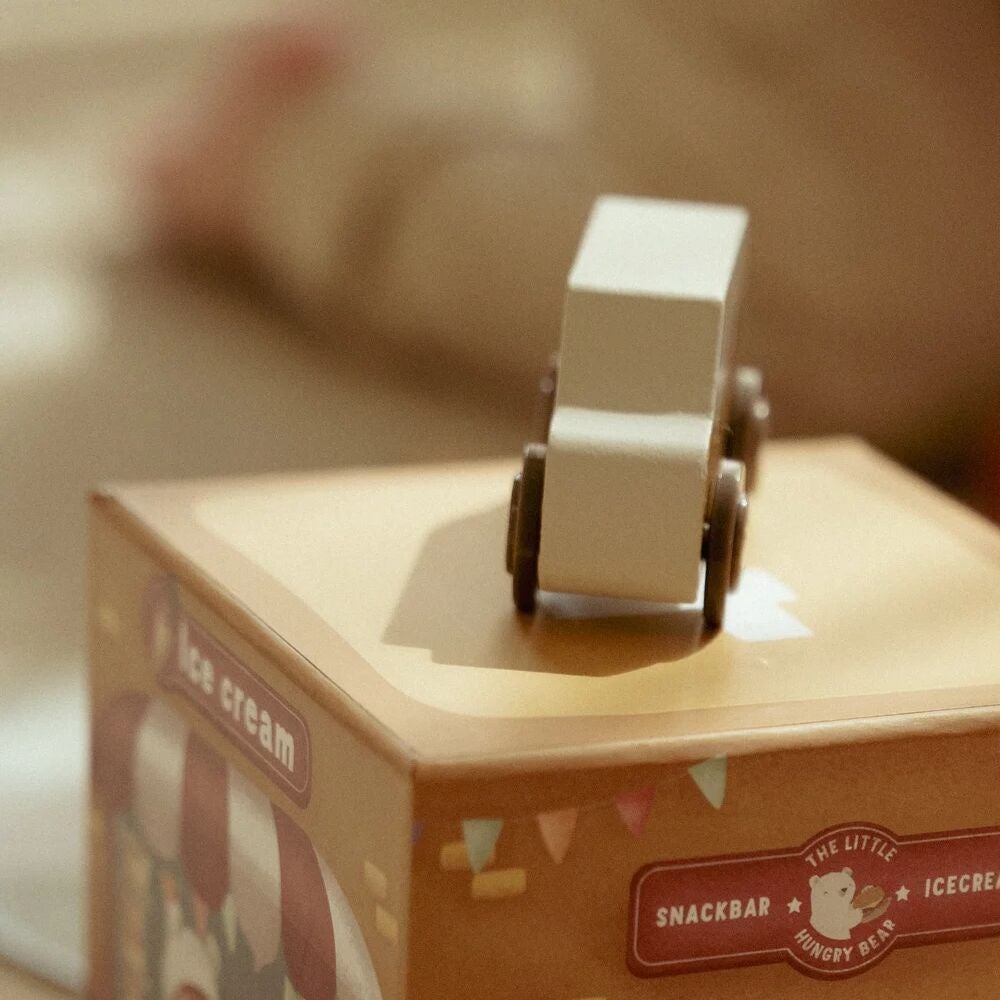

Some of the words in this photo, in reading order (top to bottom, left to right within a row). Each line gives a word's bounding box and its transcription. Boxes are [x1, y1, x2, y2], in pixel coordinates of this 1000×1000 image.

[220, 677, 294, 772] cream
[805, 839, 839, 867] THE
[844, 834, 898, 862] LITTLE
[656, 896, 770, 928] SNACKBAR
[794, 928, 853, 963] HUNGRY
[858, 919, 896, 957] BEAR
